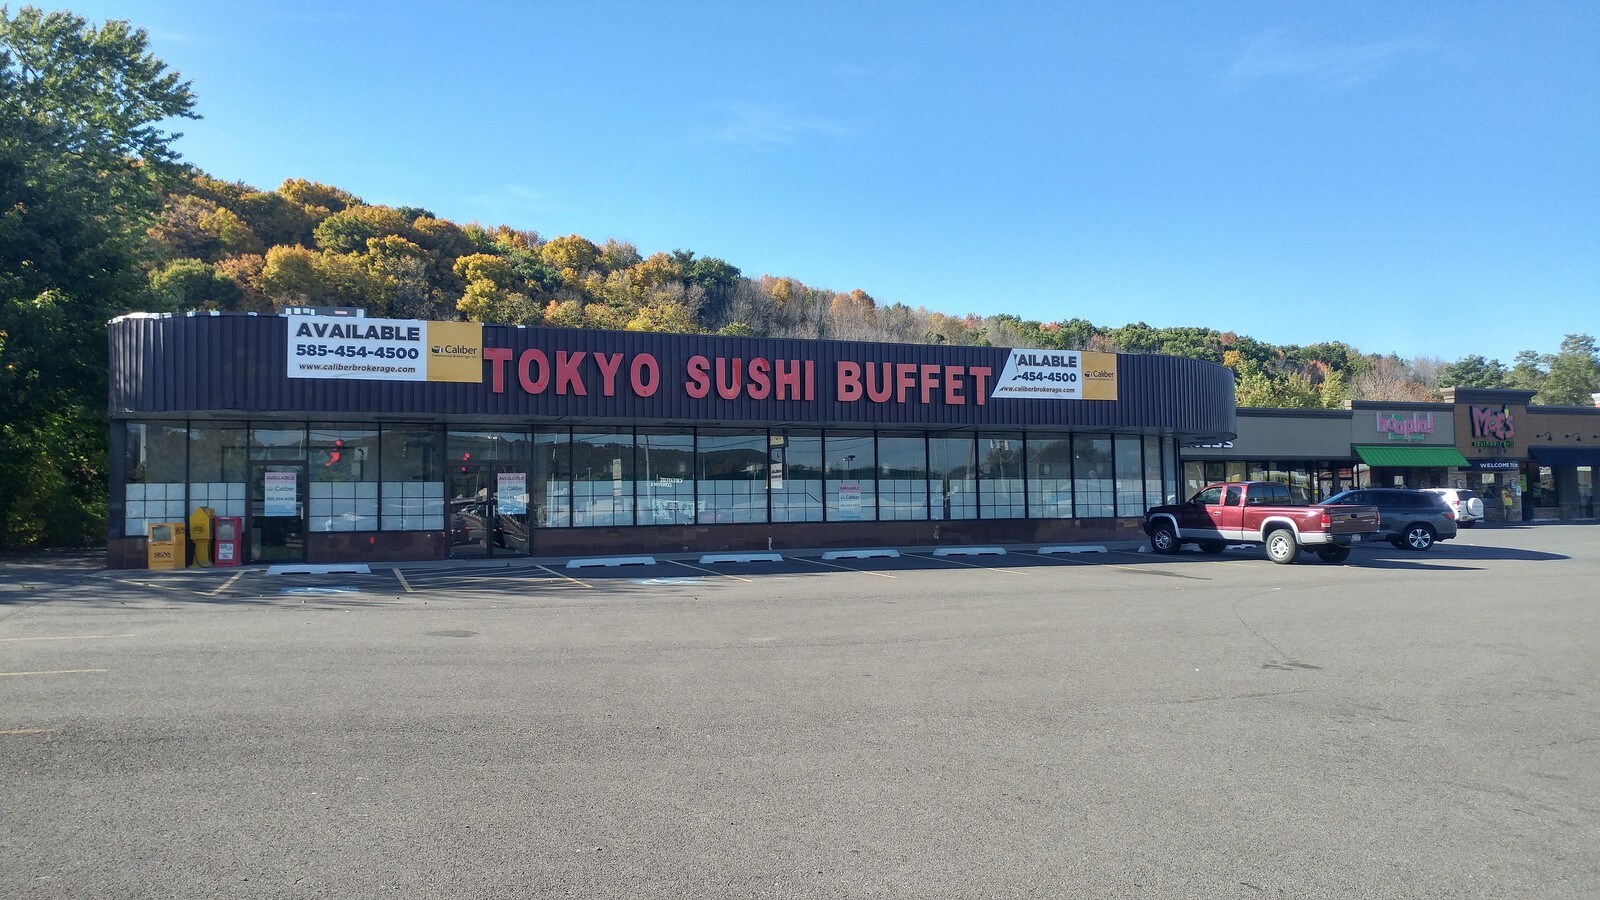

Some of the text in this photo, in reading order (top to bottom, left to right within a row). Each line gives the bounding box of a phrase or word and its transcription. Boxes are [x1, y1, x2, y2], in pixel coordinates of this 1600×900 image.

[296, 322, 420, 341] AVAILABLE
[296, 344, 419, 360] 585-454-4500
[445, 345, 477, 354] Caliber
[299, 363, 416, 373] www.caliberbrokerage.com
[1093, 370, 1114, 378] Caliber
[483, 347, 992, 405] TOKYO SUSHI BUFFET
